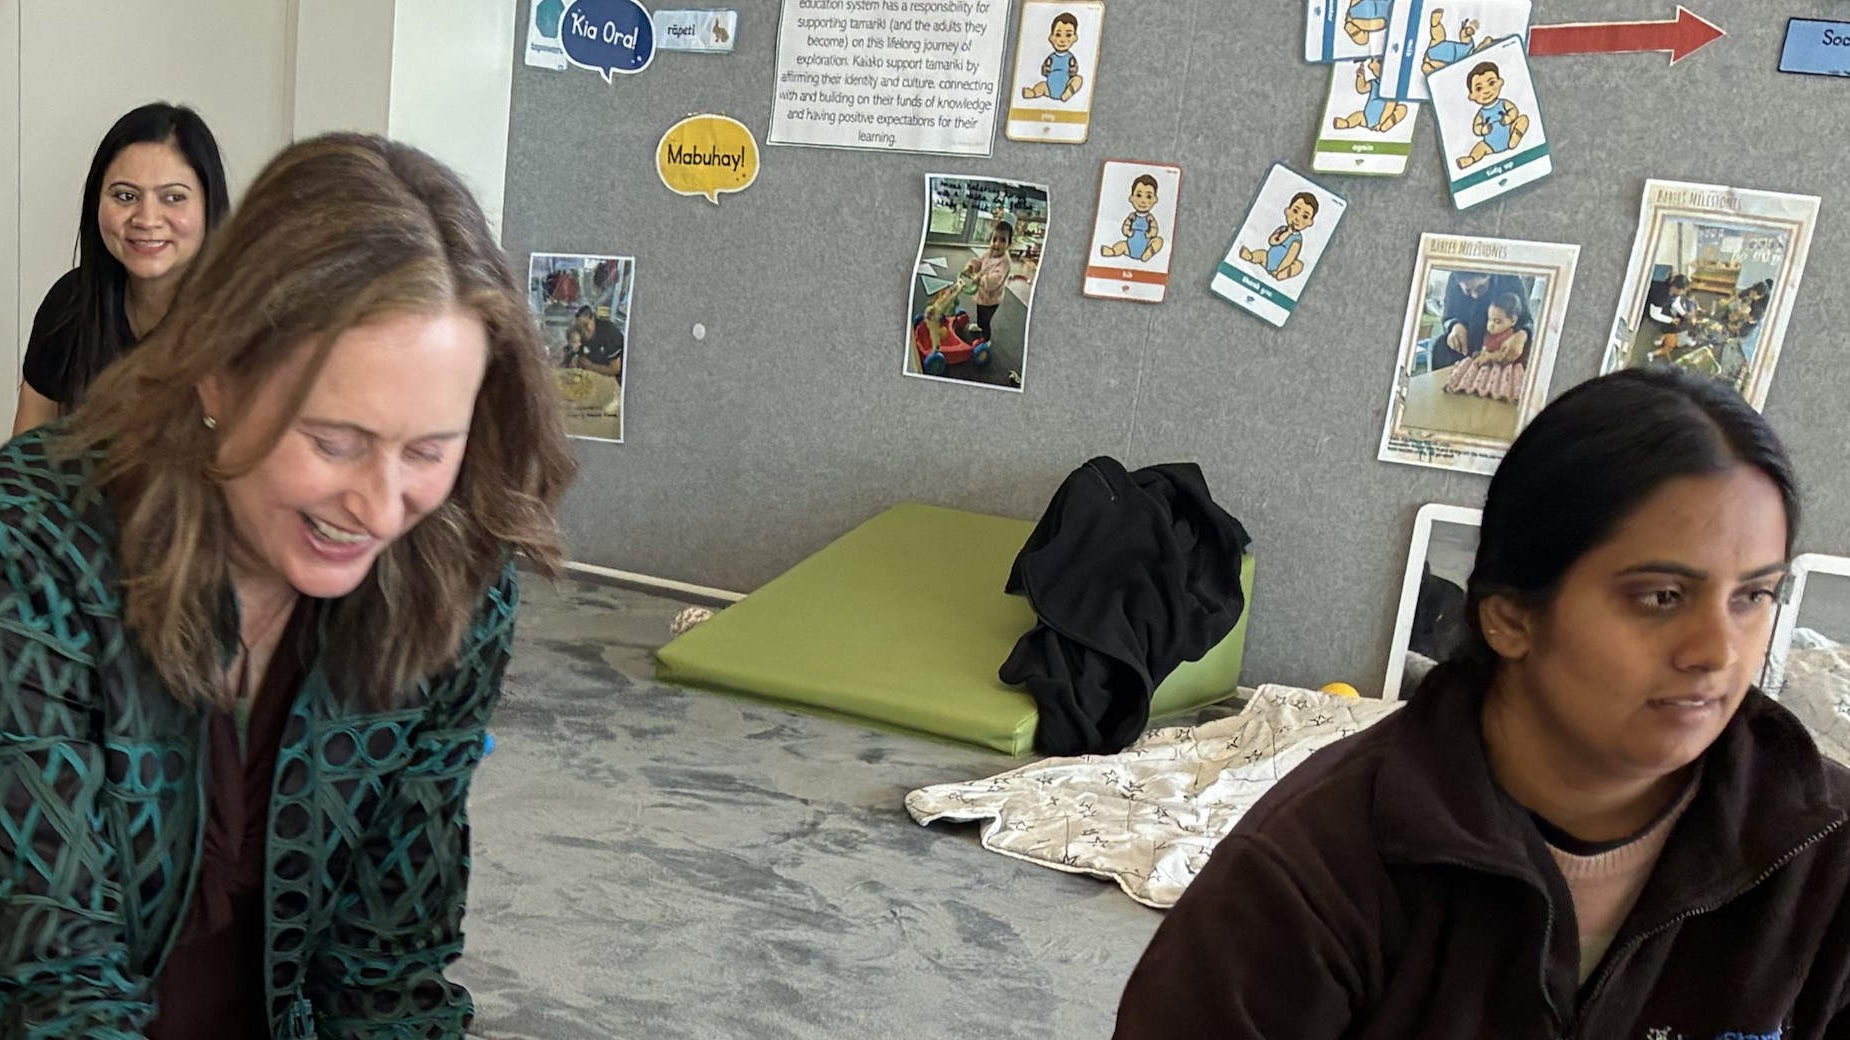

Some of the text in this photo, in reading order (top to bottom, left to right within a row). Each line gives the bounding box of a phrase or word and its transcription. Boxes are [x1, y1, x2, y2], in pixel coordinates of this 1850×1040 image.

[798, 0, 990, 16] education system has a responsibility for
[571, 12, 639, 50] Kia Ora!
[667, 24, 696, 38] rāpeti
[797, 17, 848, 32] supporting
[889, 18, 912, 32] (and
[914, 20, 931, 31] the
[933, 20, 962, 33] adults
[965, 21, 987, 36] they
[807, 34, 972, 55] become) on this lifelong journey of
[886, 57, 923, 72] support
[966, 59, 979, 75] by
[821, 73, 842, 85] their
[844, 74, 879, 89] identity
[880, 76, 900, 87] and
[939, 80, 994, 94] connecting
[799, 91, 817, 102] and
[819, 91, 855, 107] building
[857, 95, 870, 105] on
[873, 94, 894, 106] their
[897, 94, 922, 108] funds
[925, 95, 936, 108] of
[937, 96, 992, 114] knowledge
[787, 108, 978, 129] and having positive expectations for their
[667, 144, 746, 172] Mabuhay!
